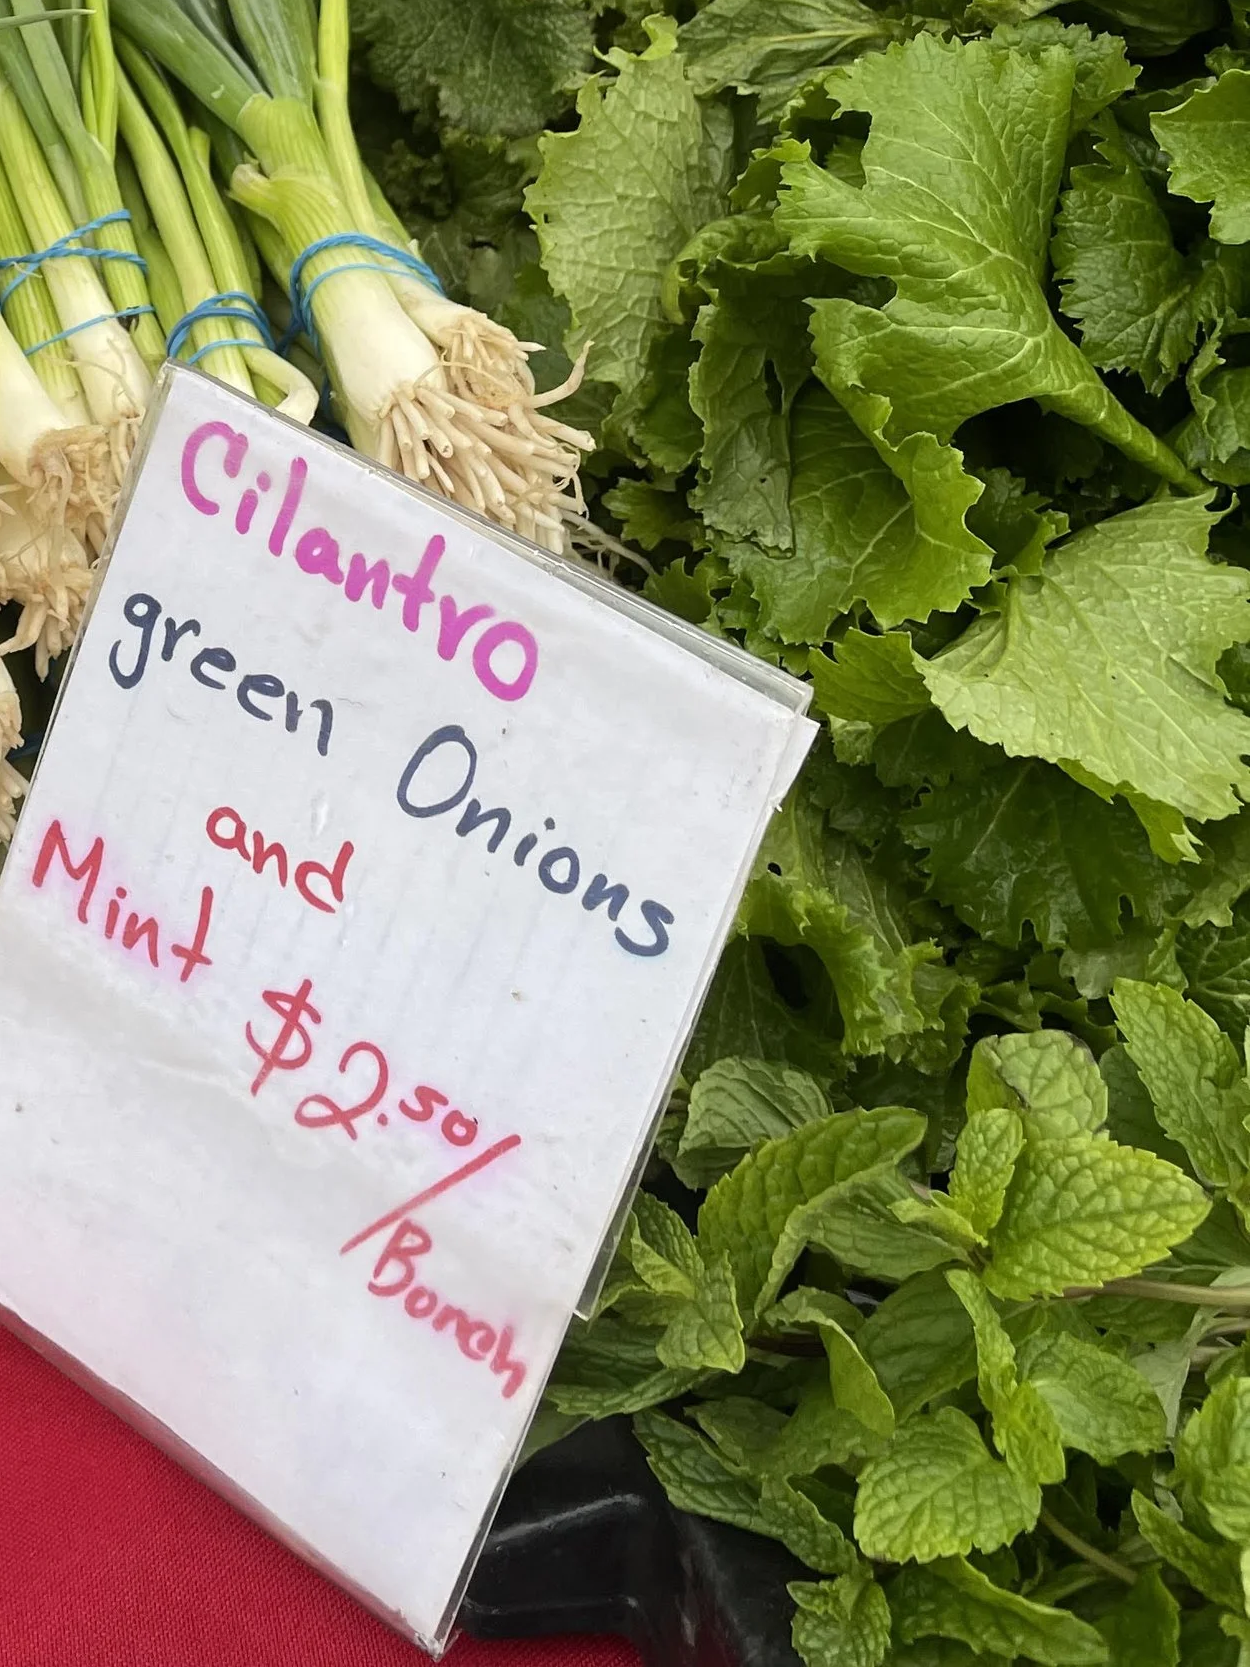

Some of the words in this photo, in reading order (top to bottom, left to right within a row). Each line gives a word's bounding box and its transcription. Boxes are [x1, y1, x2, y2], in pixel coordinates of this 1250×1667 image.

[180, 420, 538, 702] Cilantro
[107, 592, 334, 757] green
[396, 724, 675, 958] Onions
[206, 806, 354, 913] and
[32, 819, 214, 983] Mint
